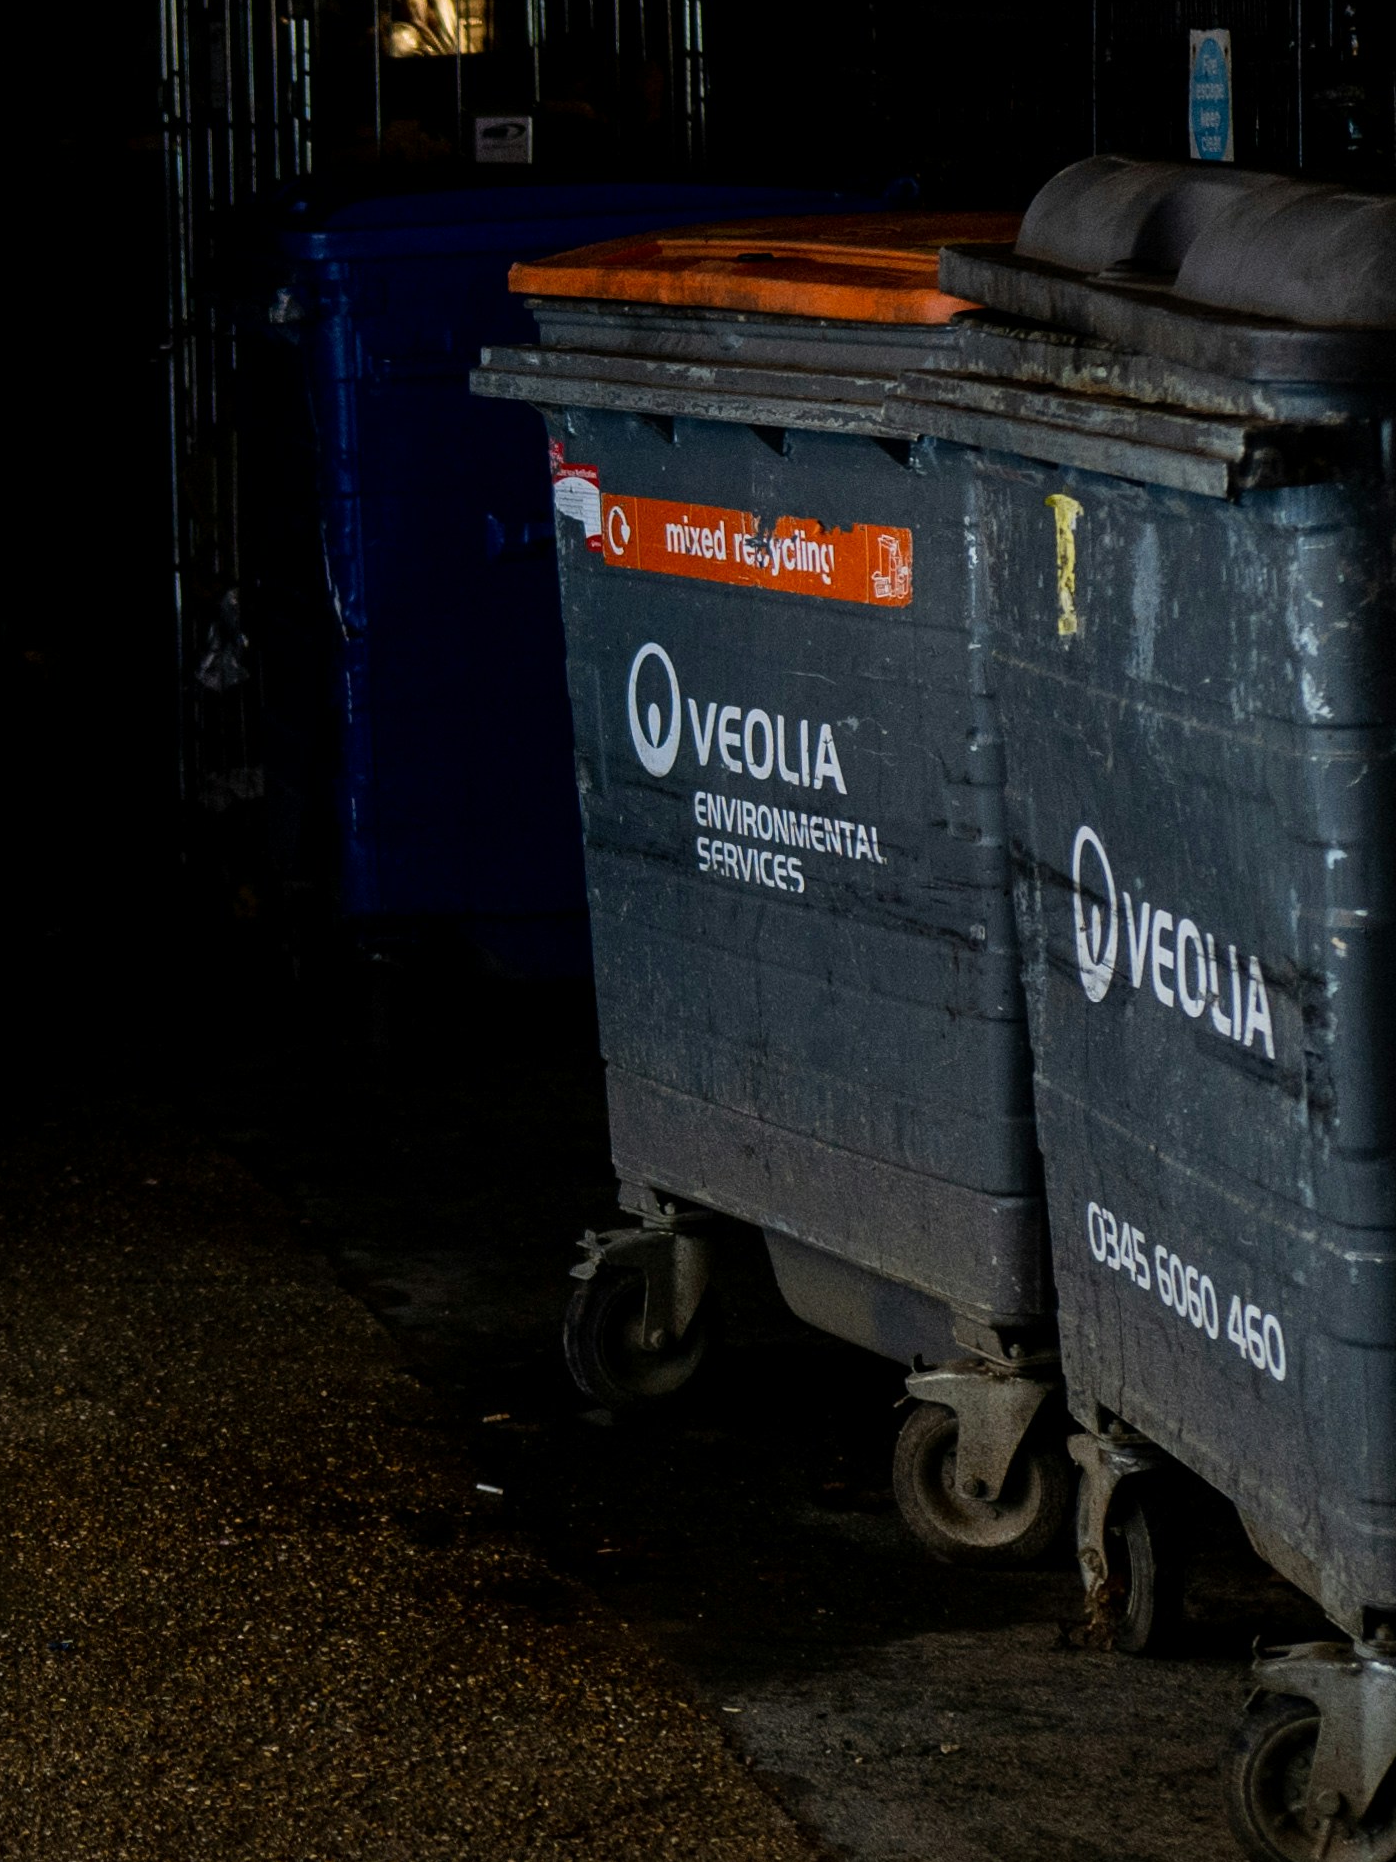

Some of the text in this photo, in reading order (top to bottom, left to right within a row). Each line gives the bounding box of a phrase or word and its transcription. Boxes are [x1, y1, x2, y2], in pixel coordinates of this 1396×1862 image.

[665, 515, 727, 561] mixed
[688, 698, 847, 795] VEOLIA
[694, 791, 888, 865] ENVIRONMENTAL
[697, 837, 805, 894] SERVICES
[1122, 891, 1276, 1060] VEOLIA
[1087, 1201, 1286, 1382] 0345 6060 460
